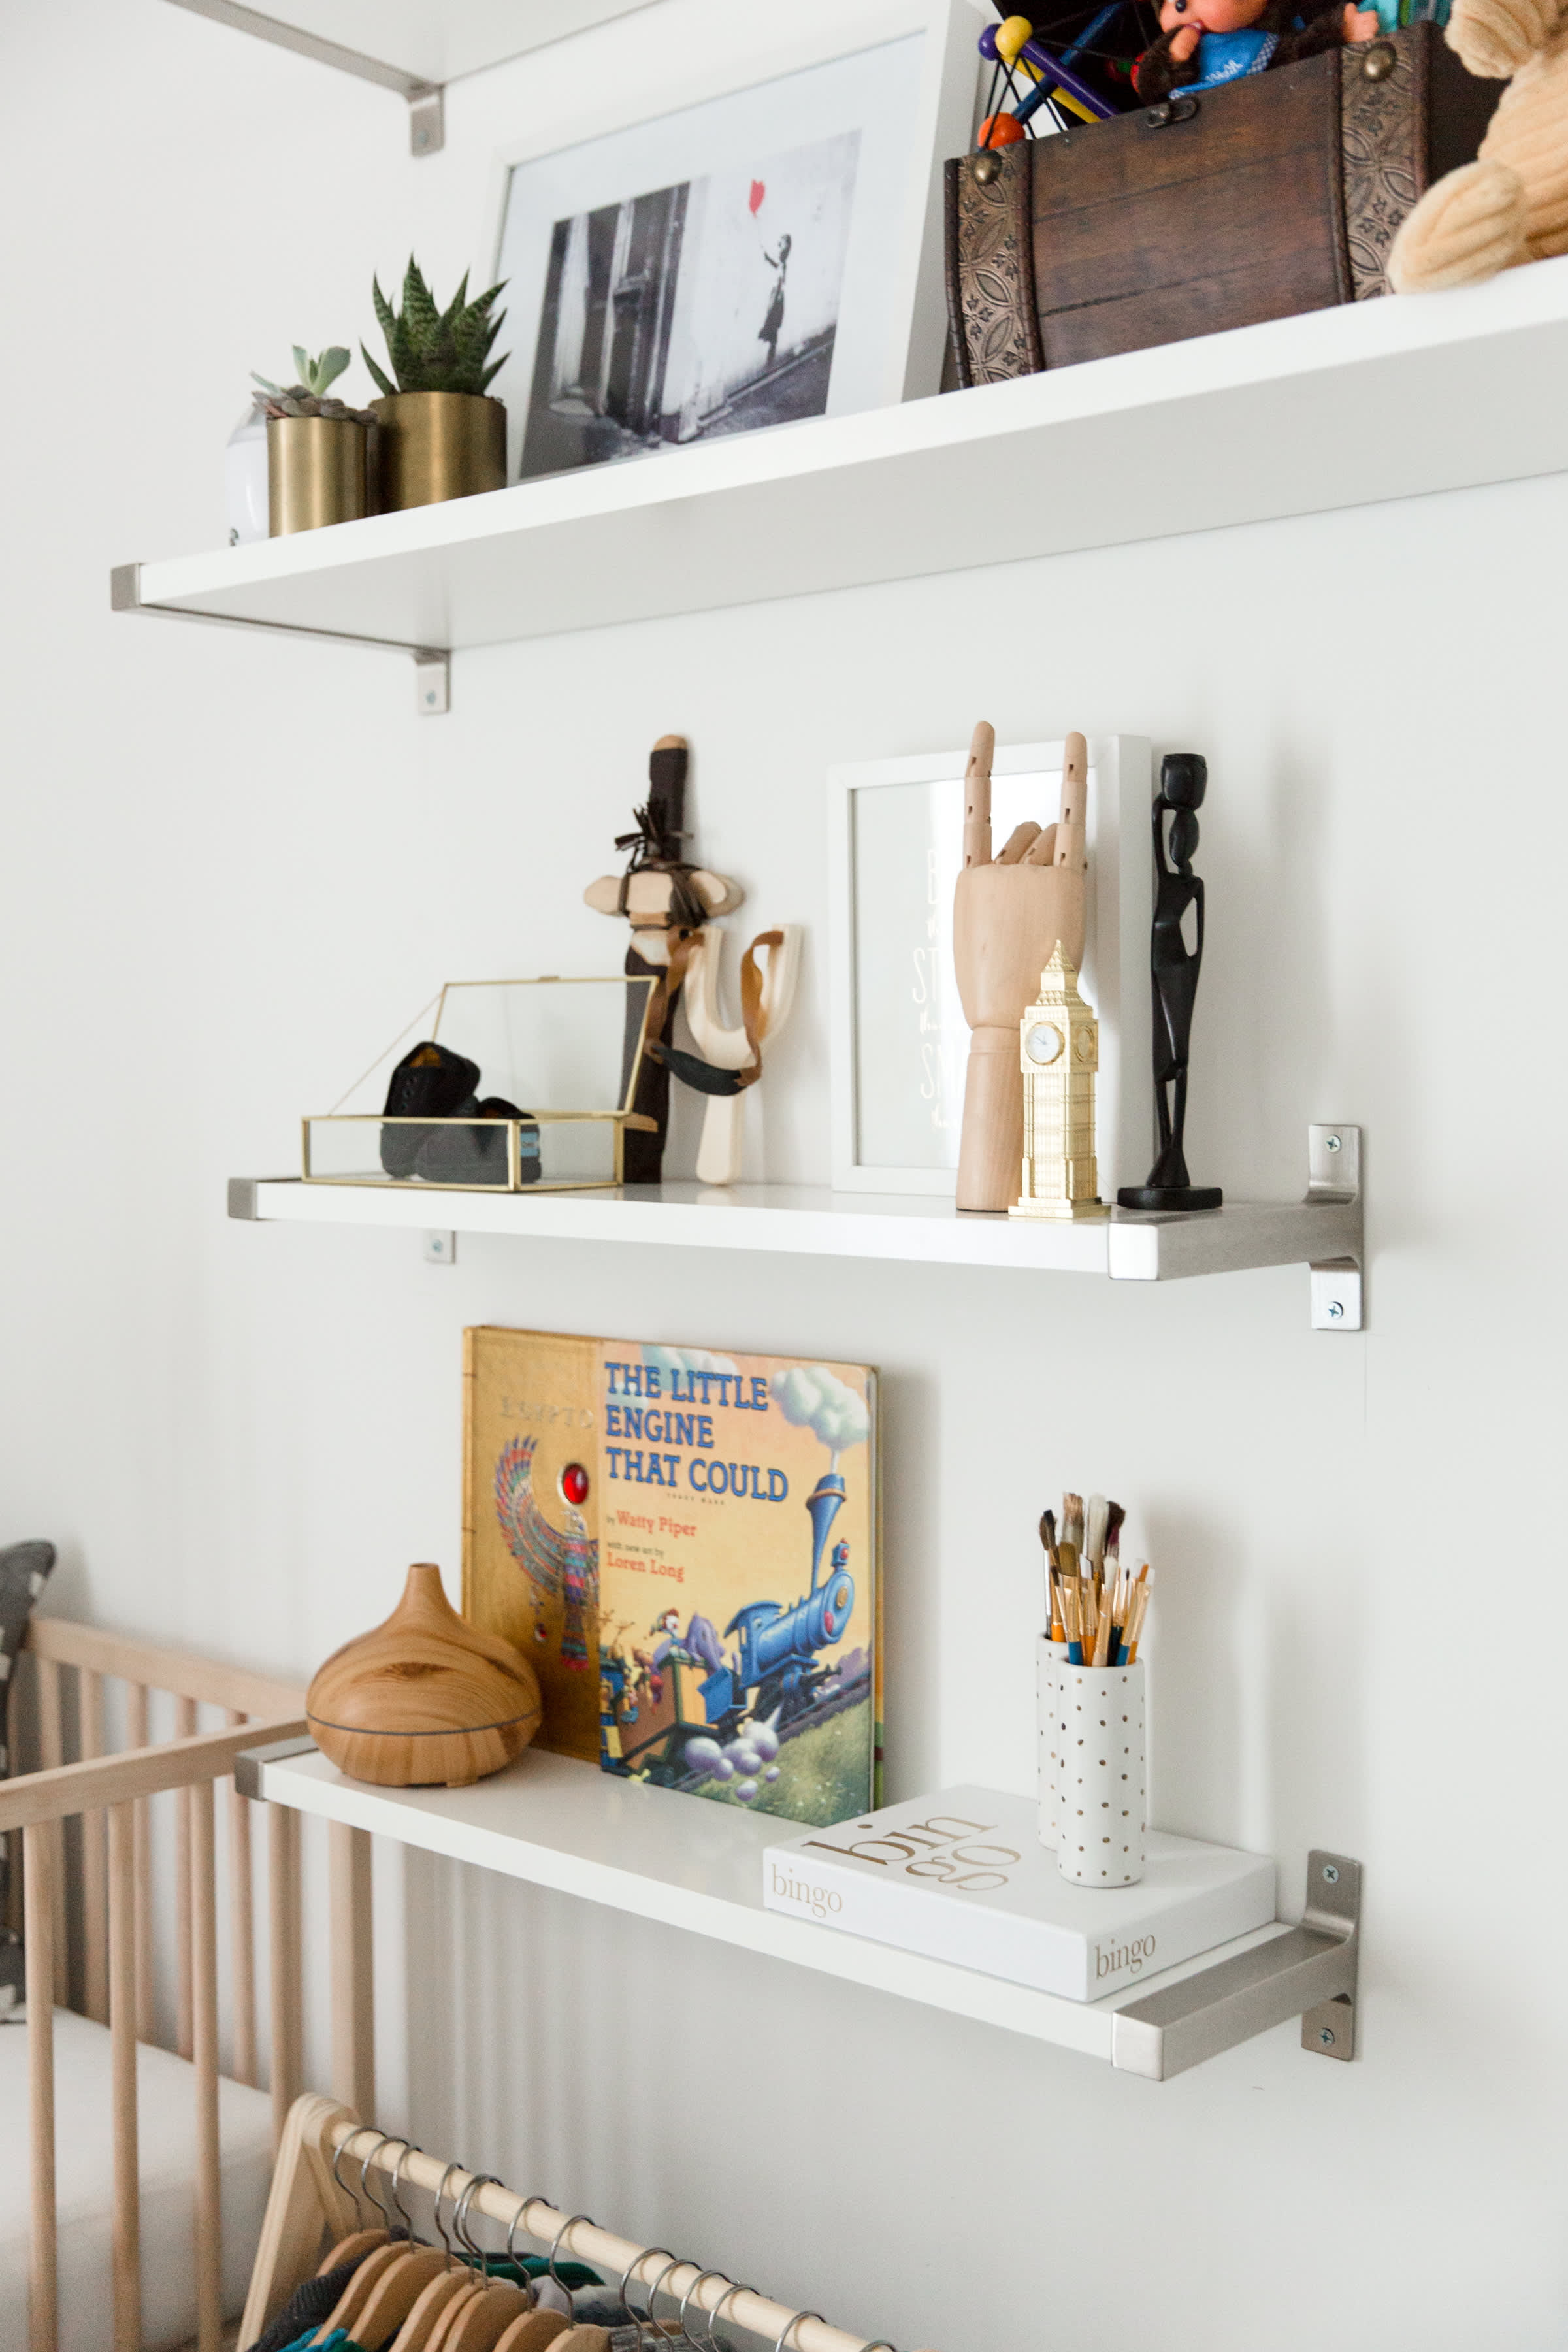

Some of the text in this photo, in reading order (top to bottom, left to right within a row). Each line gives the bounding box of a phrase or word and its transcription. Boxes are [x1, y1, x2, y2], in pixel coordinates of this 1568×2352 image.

[604, 1362, 769, 1411] THE LITTLE
[606, 1405, 714, 1448] ENGINE
[606, 1448, 788, 1502] THAT COULD
[617, 1510, 654, 1534] Watty
[659, 1516, 696, 1538] Piper
[607, 1552, 684, 1583] Loren Long
[801, 1815, 997, 1865] bin
[905, 1844, 1021, 1891] go
[772, 1864, 843, 1919] bingo
[1095, 1934, 1156, 1980] bingo
